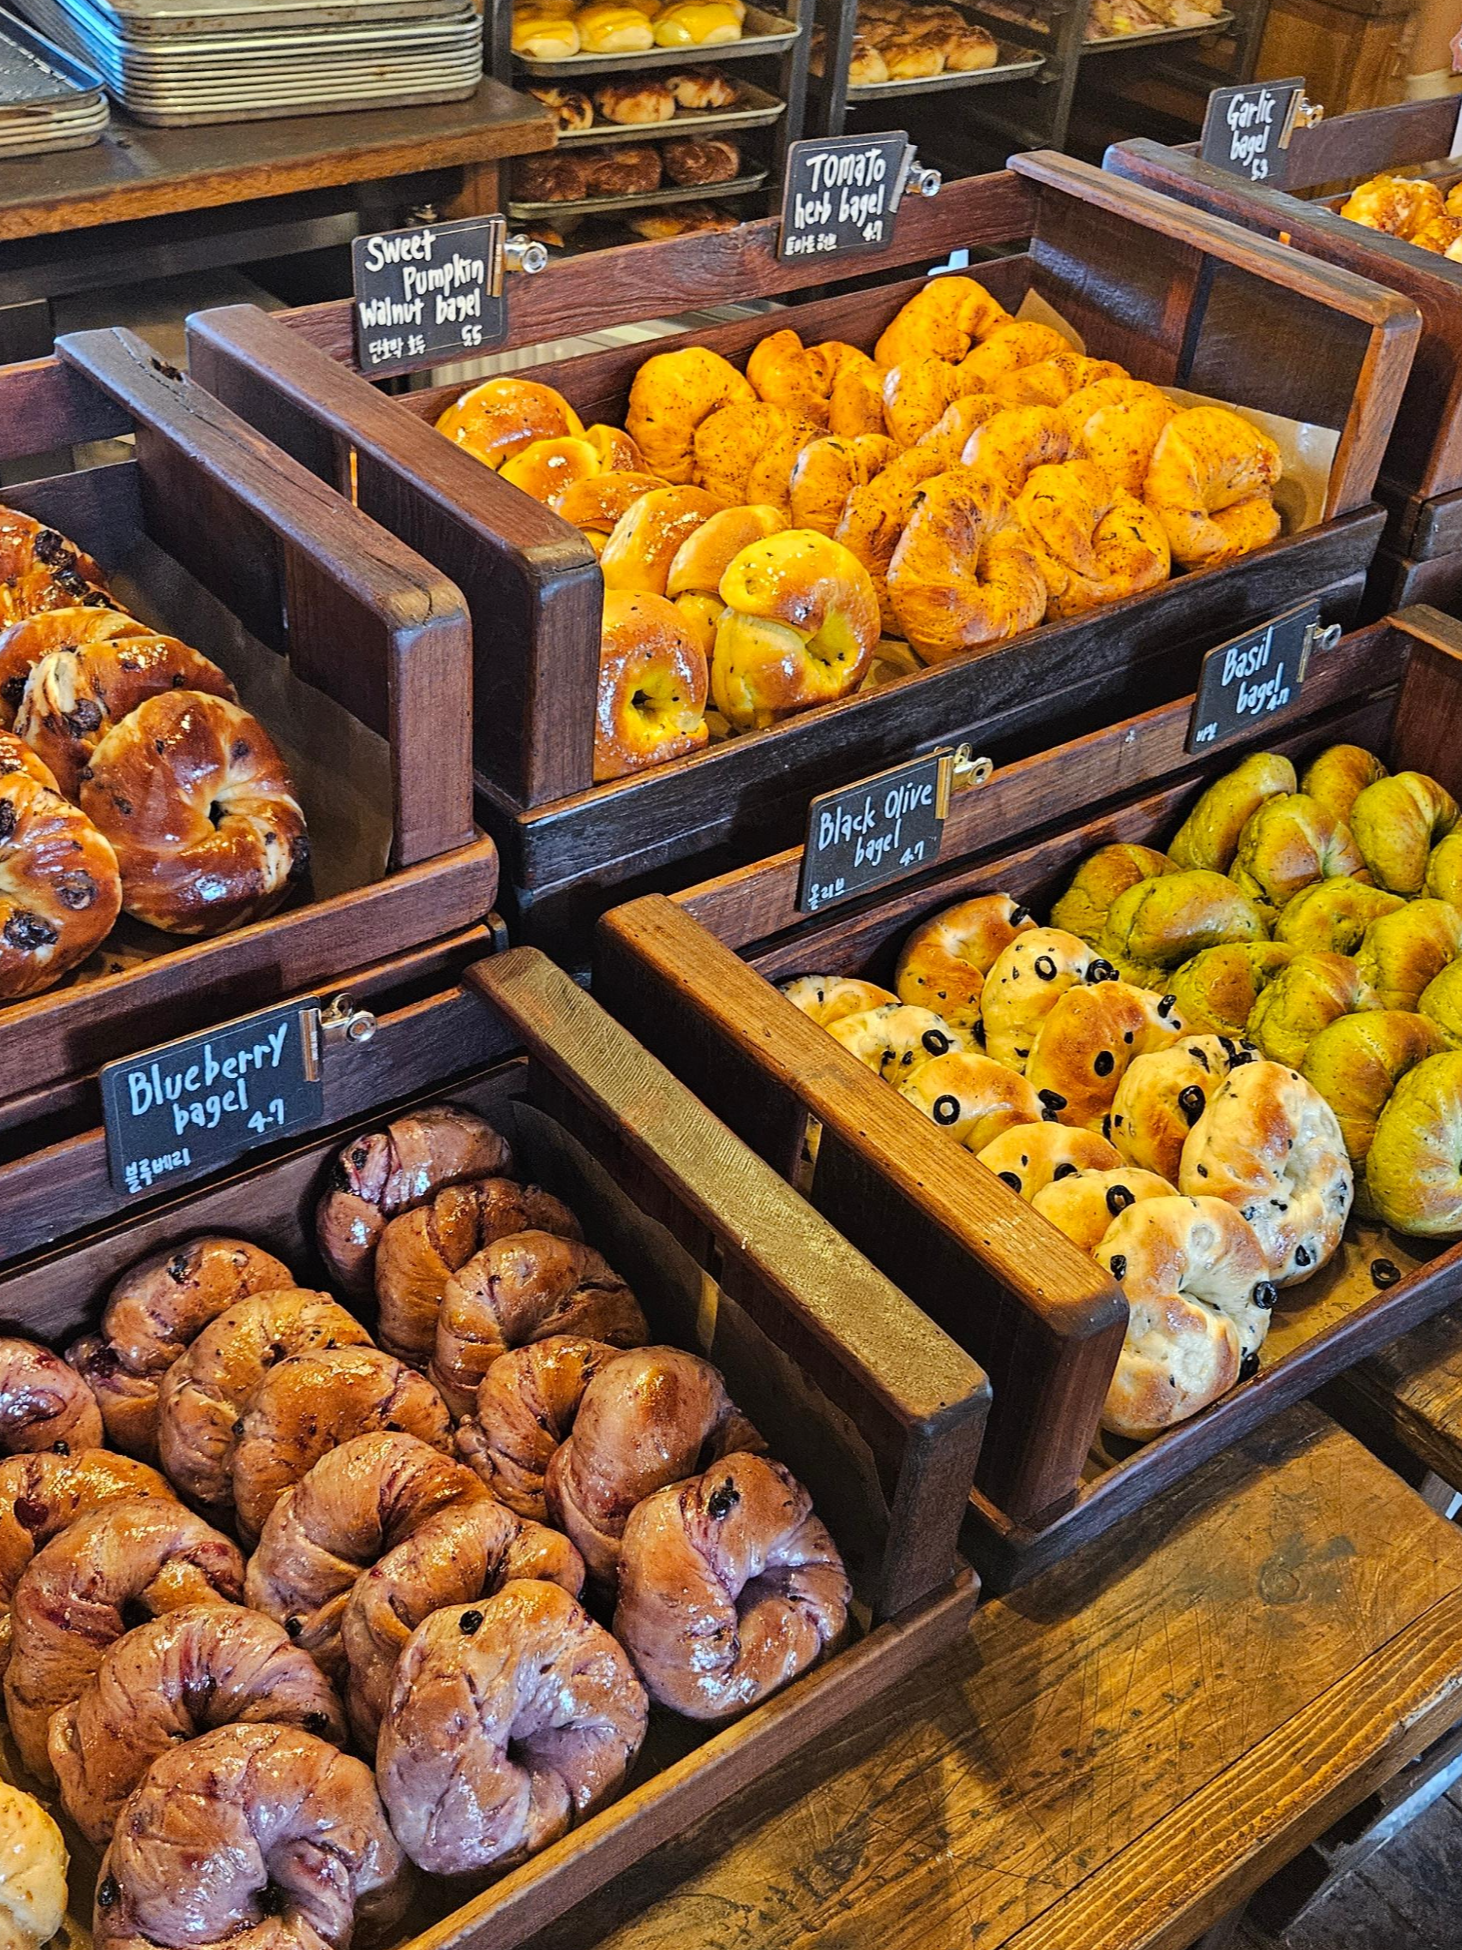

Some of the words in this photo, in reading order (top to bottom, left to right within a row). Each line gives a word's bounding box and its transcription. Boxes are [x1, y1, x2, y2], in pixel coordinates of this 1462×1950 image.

[1227, 89, 1275, 131] Garlic
[1230, 125, 1270, 166] bagel
[794, 191, 832, 229] herb
[838, 184, 886, 228] bagel
[364, 229, 436, 272] Sweet
[862, 220, 884, 242] 4.7
[403, 253, 485, 302] Pumpkin
[359, 297, 424, 330] Walnut
[435, 288, 481, 325] bagel
[369, 337, 404, 365] 단호박
[1221, 625, 1274, 687] Basil
[1236, 662, 1284, 715] bagel
[818, 796, 876, 852] Black
[884, 781, 933, 820] Olive
[853, 818, 902, 868] bagel
[899, 840, 925, 867] 4.7
[808, 877, 846, 911] 올리브
[127, 1022, 288, 1117] Blueberry
[172, 1077, 249, 1136] bagel
[247, 1098, 285, 1134] 4.7
[124, 1147, 192, 1195] 블루베리
